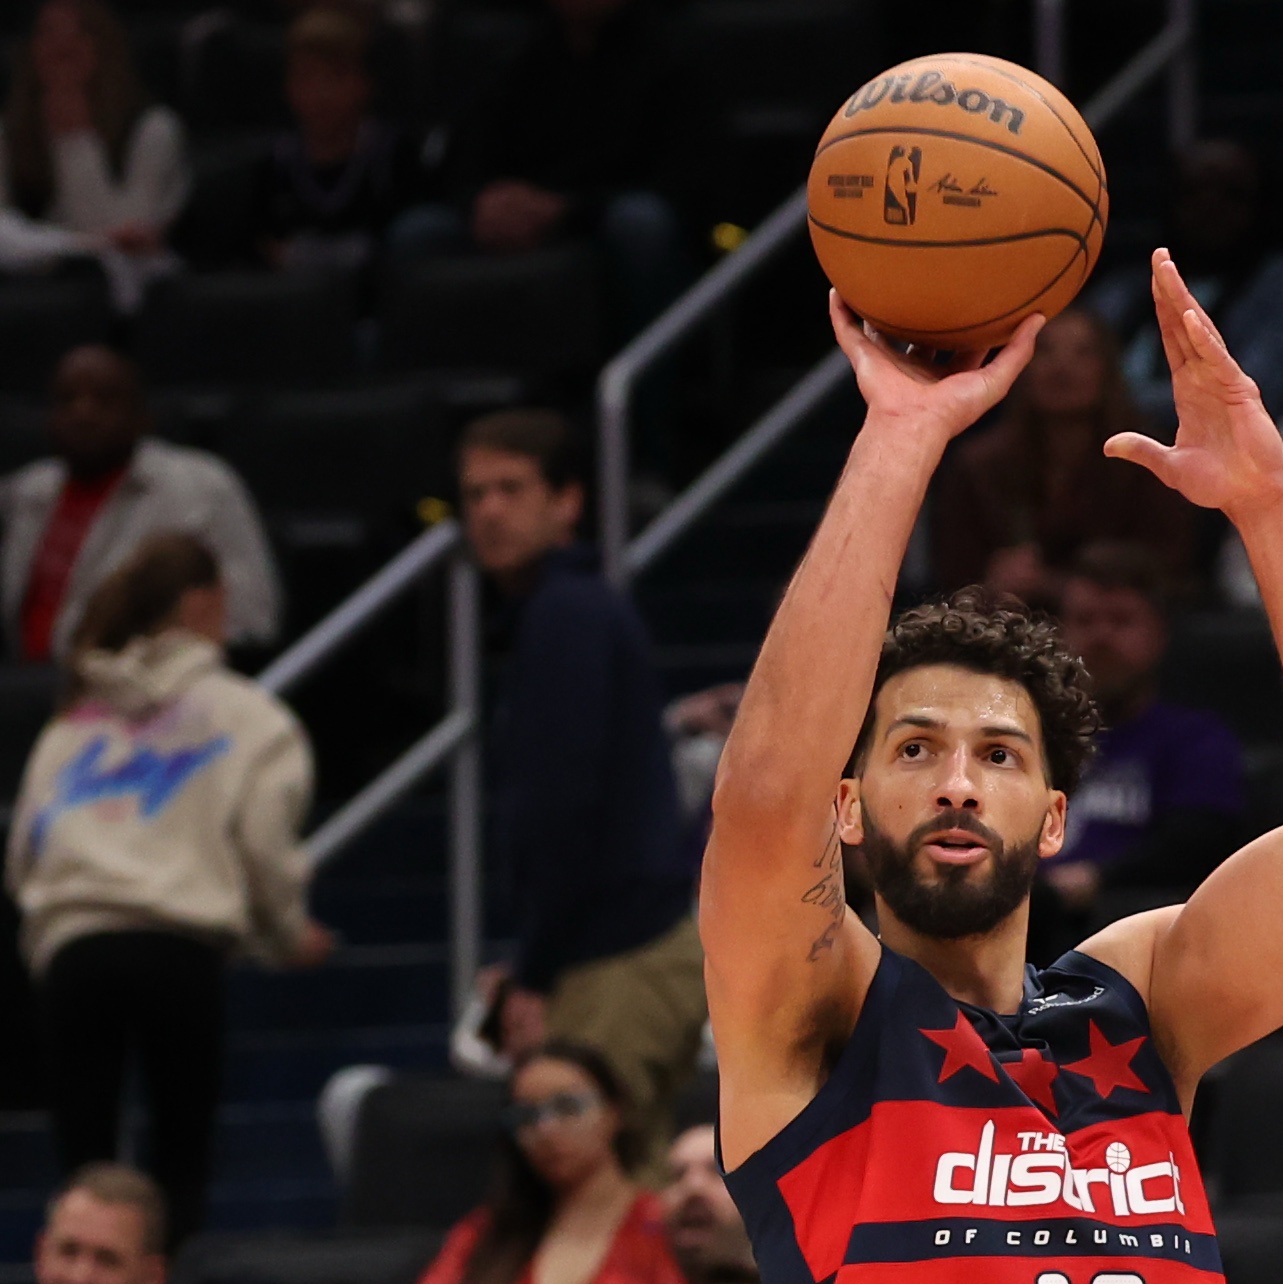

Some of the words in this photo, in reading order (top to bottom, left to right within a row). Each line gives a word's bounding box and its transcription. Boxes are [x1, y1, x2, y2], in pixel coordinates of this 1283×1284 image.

[844, 70, 1026, 135] Wilson
[1017, 1132, 1067, 1152] THE
[933, 1119, 1186, 1217] district
[934, 1229, 978, 1246] OF
